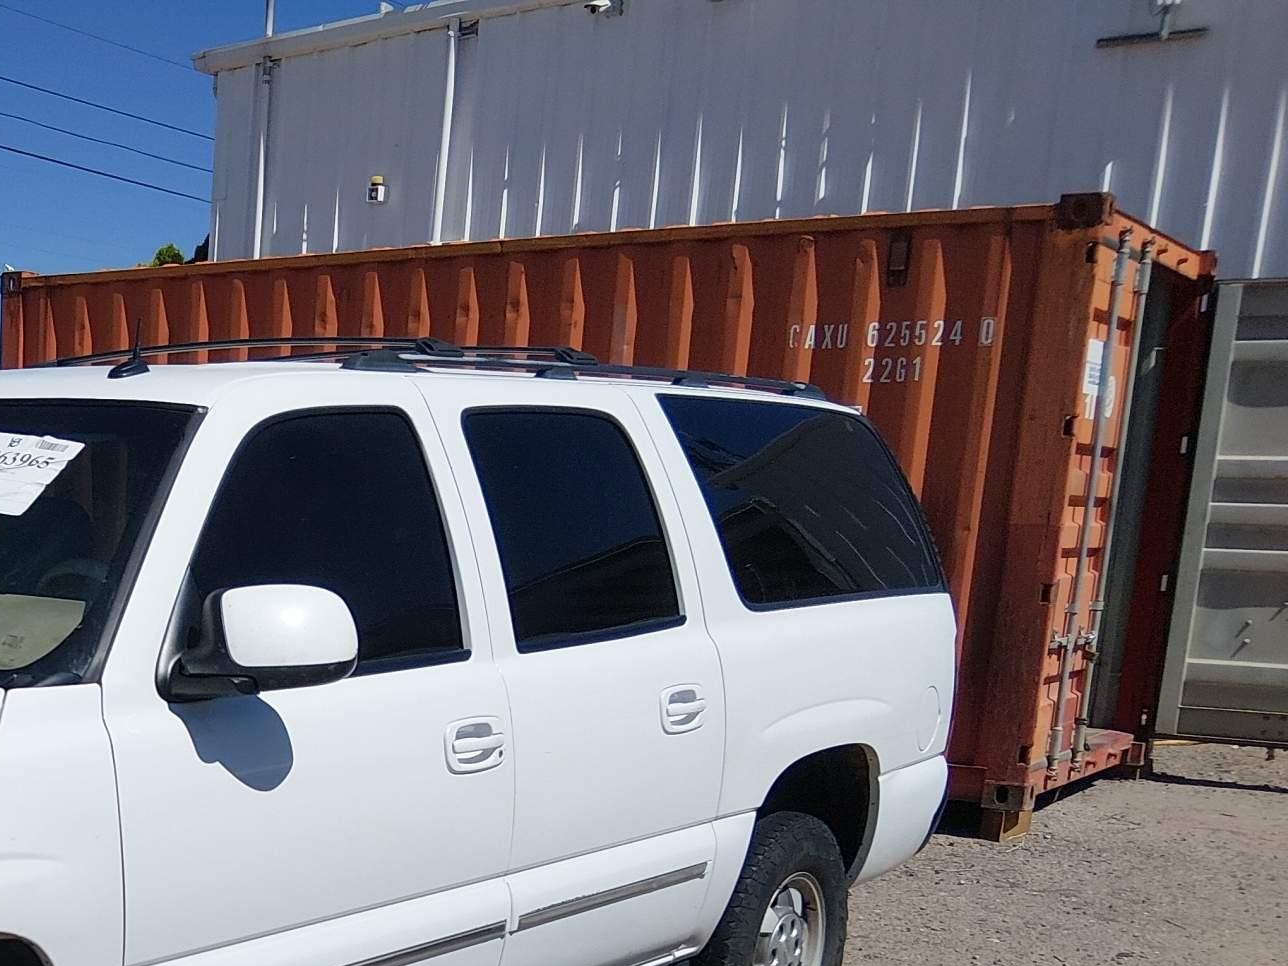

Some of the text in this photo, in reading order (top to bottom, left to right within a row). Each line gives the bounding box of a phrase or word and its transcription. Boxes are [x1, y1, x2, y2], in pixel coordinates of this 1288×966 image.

[788, 318, 996, 349] CAXU 625524 0
[862, 356, 922, 383] 22G1
